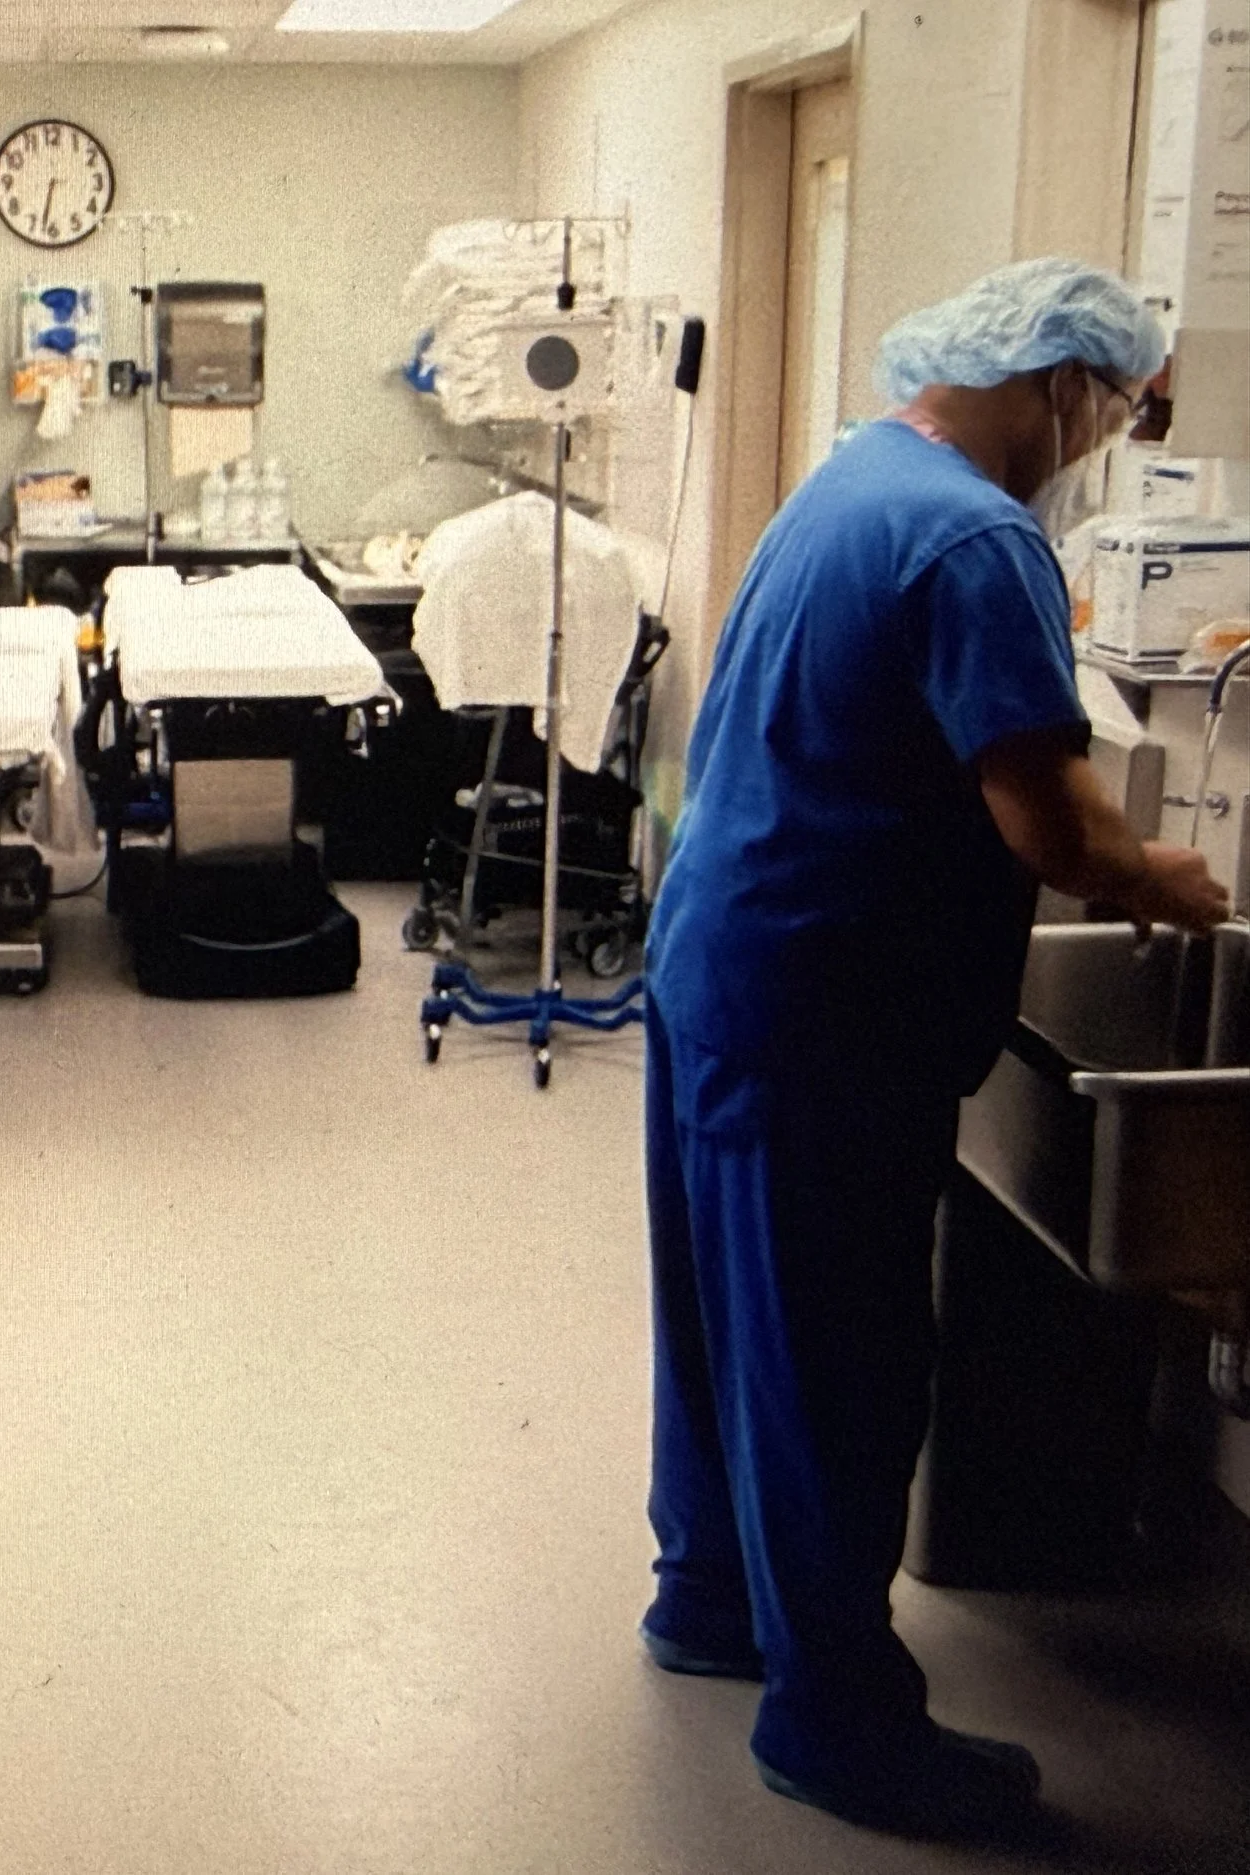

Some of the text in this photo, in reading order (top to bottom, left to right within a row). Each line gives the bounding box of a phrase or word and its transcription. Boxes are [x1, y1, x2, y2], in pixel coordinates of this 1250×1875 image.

[24, 131, 37, 152] 11
[43, 125, 60, 146] 12
[86, 148, 97, 167] 2
[1, 173, 13, 191] 9
[92, 172, 103, 192] 3
[8, 196, 20, 217] 8
[86, 196, 97, 215] 4
[25, 213, 37, 232] 7
[47, 221, 60, 239] 6
[70, 212, 82, 232] 5
[1141, 561, 1172, 590] P
